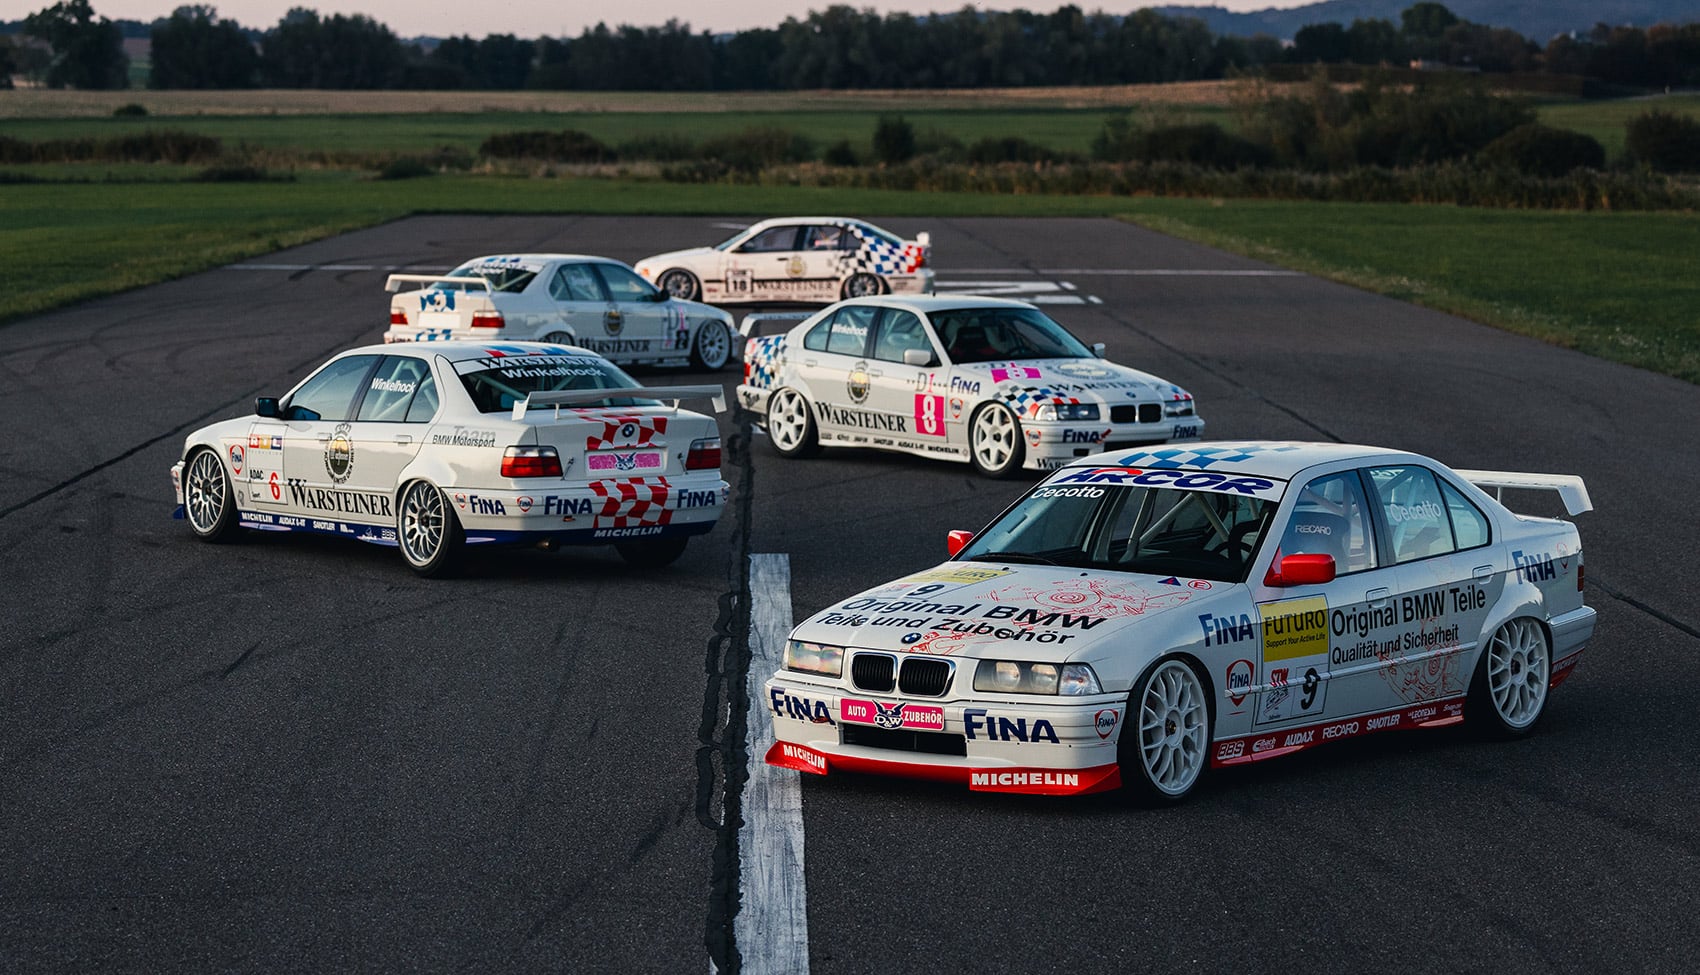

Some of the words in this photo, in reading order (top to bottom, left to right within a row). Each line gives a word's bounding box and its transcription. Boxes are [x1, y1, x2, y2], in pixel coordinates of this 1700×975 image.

[579, 337, 651, 353] WARSTEINER
[478, 357, 600, 369] WARSTEINER
[501, 367, 606, 379] Winkelhock
[371, 377, 416, 393] Winkelhock
[950, 376, 980, 395] FINA
[815, 401, 907, 433] WARSTEINER
[922, 395, 937, 433] 8
[432, 434, 452, 445] BMW
[452, 435, 496, 447] Motorsport
[454, 425, 496, 440] Team
[1062, 428, 1101, 443] FINA
[1173, 424, 1198, 439] FINA
[251, 438, 280, 447] RTL
[928, 445, 959, 454] MICHELIN
[231, 452, 243, 462] FINA
[250, 469, 264, 480] ADAC
[1052, 468, 1274, 495] ARCOR
[269, 472, 281, 500] 6
[1031, 486, 1105, 499] Cecotto
[287, 477, 392, 517] WARSTEINER
[469, 495, 506, 516] FINA
[519, 500, 531, 508] FINA
[544, 496, 593, 515] FINA
[677, 488, 716, 508] FINA
[241, 512, 273, 524] MICHELIN
[1390, 500, 1441, 522] Cecotto
[594, 526, 663, 538] MICHELIN
[1295, 524, 1331, 536] RECARO
[1511, 550, 1556, 585] FINA
[907, 584, 945, 596] 9
[842, 597, 981, 617] Original
[982, 603, 1104, 631] BMW
[1331, 599, 1398, 638] Original
[1402, 590, 1445, 623] BMW
[1449, 584, 1486, 613] Teile
[816, 612, 867, 627] Teile
[870, 614, 929, 629] und
[930, 618, 1076, 646] Zubehör
[1198, 613, 1254, 647] FINA
[1264, 609, 1326, 637] FUTURO
[1266, 637, 1287, 649] Support
[1288, 636, 1299, 645] Your
[1299, 634, 1316, 643] Active
[1316, 632, 1326, 641] Life
[1332, 640, 1377, 665] Qualität
[1380, 634, 1401, 655] und
[1403, 623, 1459, 650] Sicherheit
[1230, 672, 1249, 688] FINA
[1301, 667, 1321, 711] 9
[770, 687, 835, 726] FINA
[847, 705, 867, 718] AUTO
[874, 715, 904, 729] D&W
[904, 709, 943, 725] ZUBEHÖR
[963, 708, 1060, 744] FINA
[1097, 716, 1116, 728] FINA
[1366, 713, 1401, 732] SANDTLER
[1284, 730, 1314, 747] AUDAX
[1322, 721, 1359, 740] RECARO
[783, 744, 825, 769] MICHELIN
[1217, 740, 1245, 760] BBS
[971, 772, 1079, 787] MICHELIN
